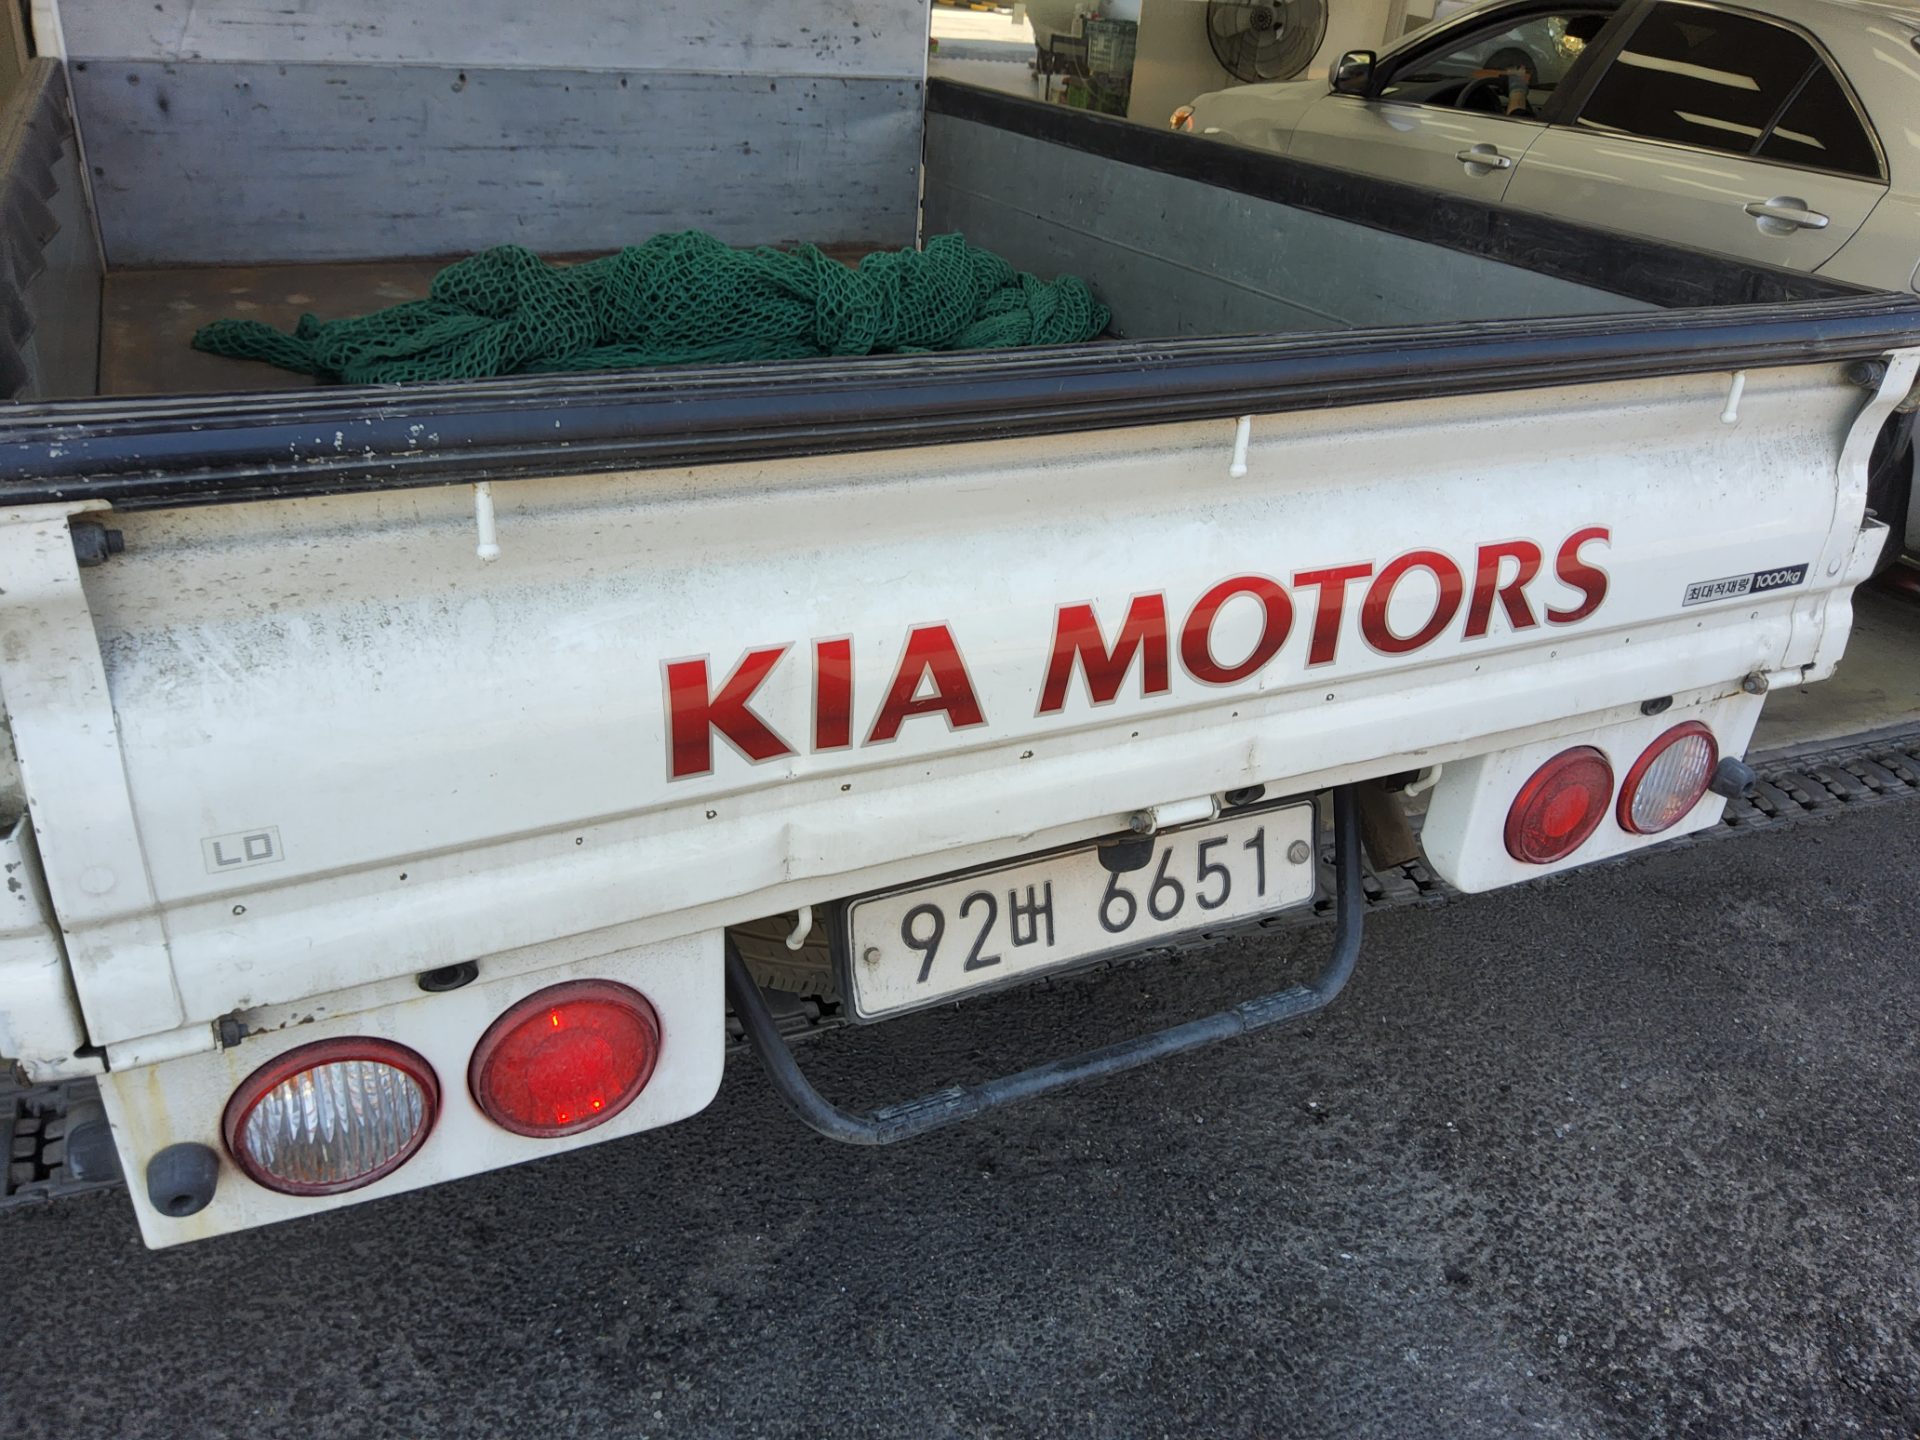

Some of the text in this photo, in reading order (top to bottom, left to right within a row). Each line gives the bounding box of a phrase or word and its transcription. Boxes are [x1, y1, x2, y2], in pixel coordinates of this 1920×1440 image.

[1687, 570, 1801, 600] 최대적재량 1000kg
[662, 524, 1613, 783] KIA MOTORS
[1099, 826, 1266, 935] 6651
